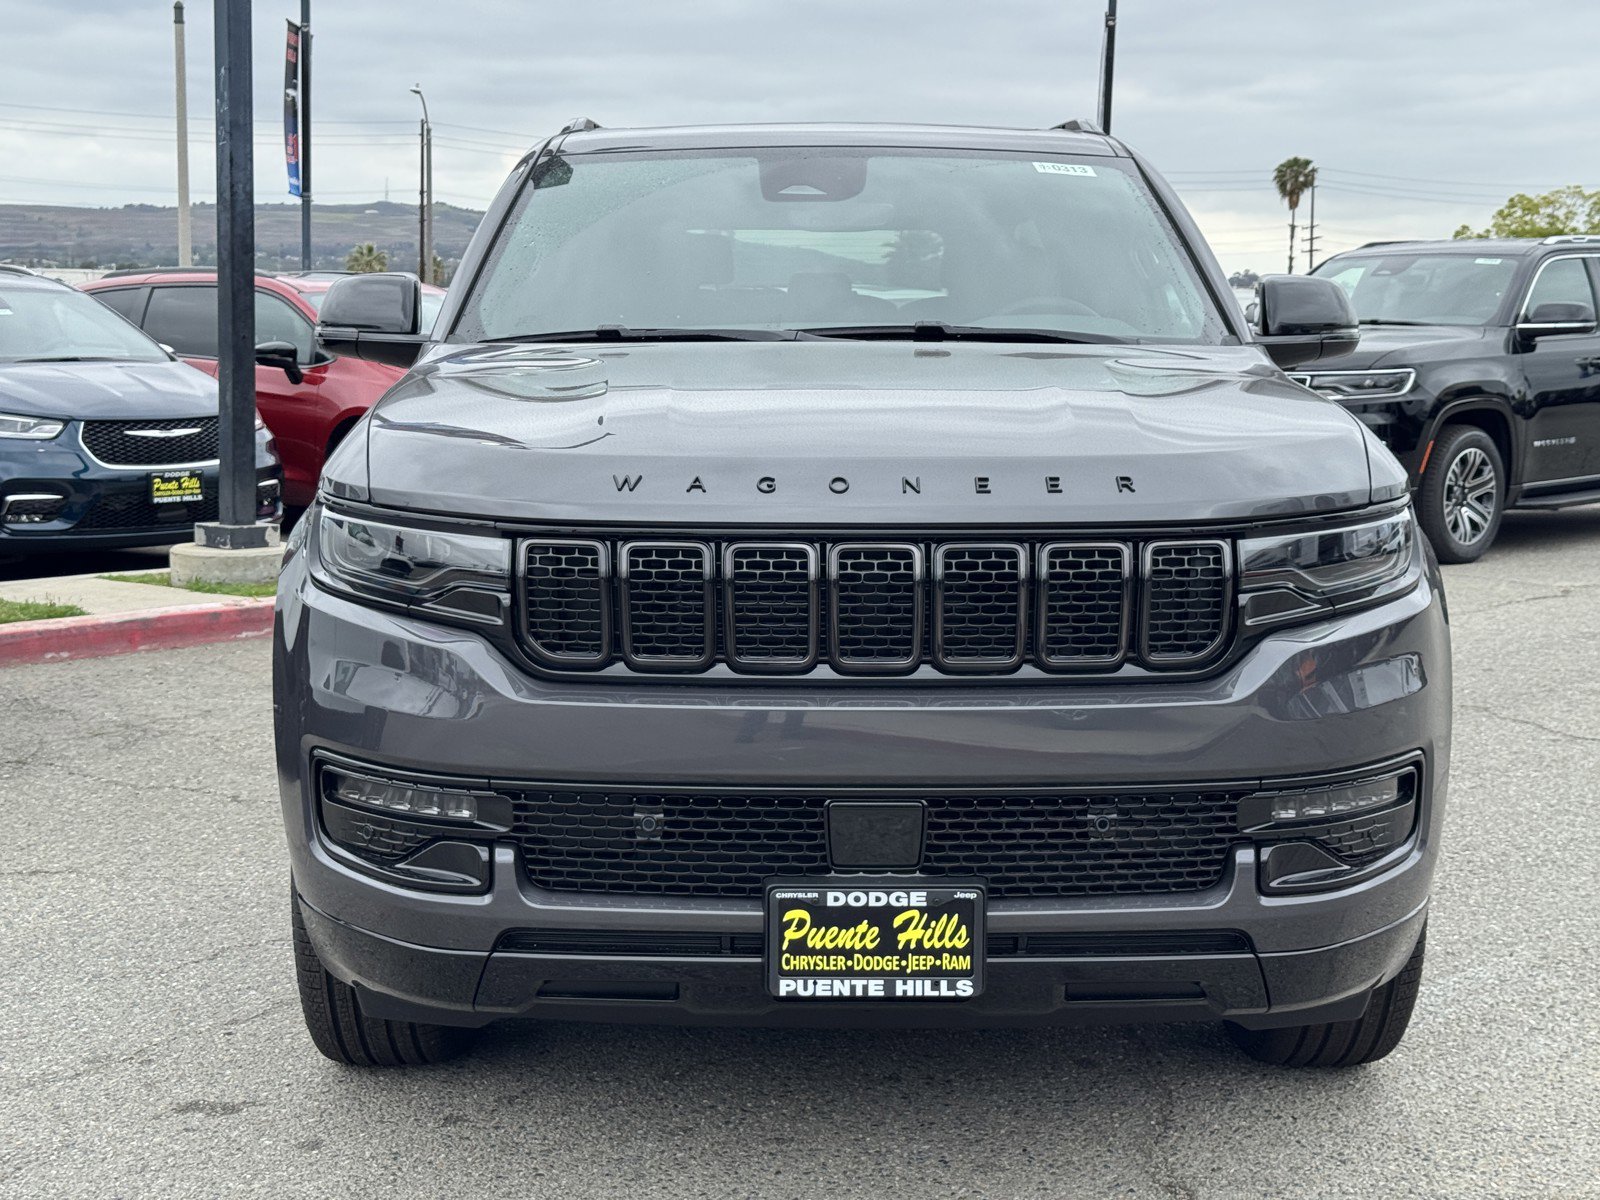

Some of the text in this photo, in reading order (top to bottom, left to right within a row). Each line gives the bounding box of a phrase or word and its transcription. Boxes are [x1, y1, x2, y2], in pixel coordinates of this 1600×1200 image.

[613, 475, 1136, 494] WAGONEER
[827, 892, 927, 907] DODGE
[954, 892, 977, 900] Jeep
[782, 909, 970, 951] Puente Hills
[779, 980, 974, 996] PUENTE HILLS
